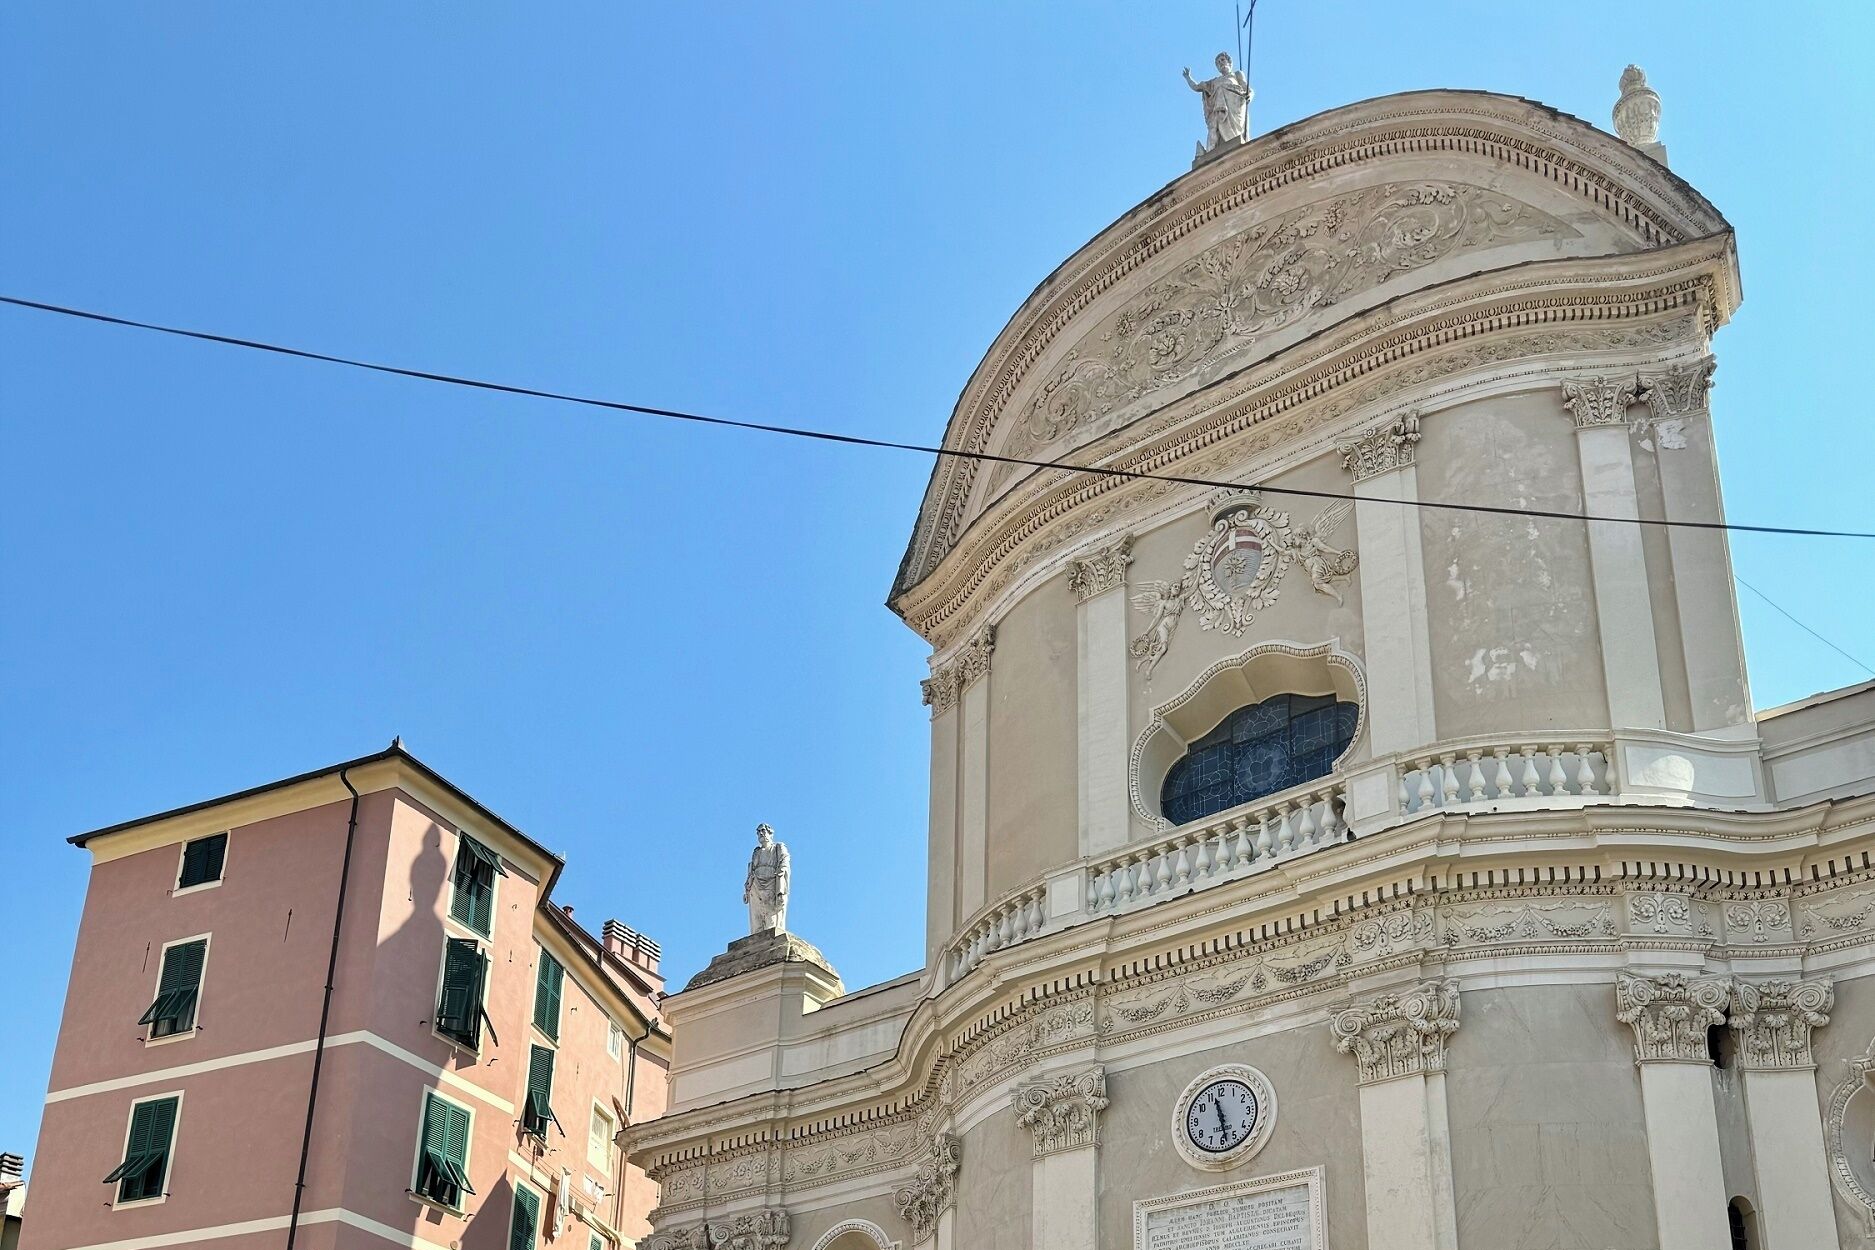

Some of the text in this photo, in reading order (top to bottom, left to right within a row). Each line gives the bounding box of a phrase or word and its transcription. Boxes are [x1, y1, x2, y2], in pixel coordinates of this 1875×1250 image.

[1218, 1087, 1225, 1098] 12
[1232, 1088, 1235, 1097] 1
[1208, 1093, 1214, 1102] 11
[1240, 1094, 1246, 1103] 2
[1199, 1103, 1206, 1113] 10
[1246, 1106, 1251, 1115] 3
[1194, 1118, 1199, 1126] 9
[1242, 1120, 1246, 1128] 4
[1198, 1129, 1204, 1138] 8
[1232, 1130, 1237, 1140] 5
[1208, 1136, 1213, 1145] 7
[1220, 1134, 1225, 1145] 6
